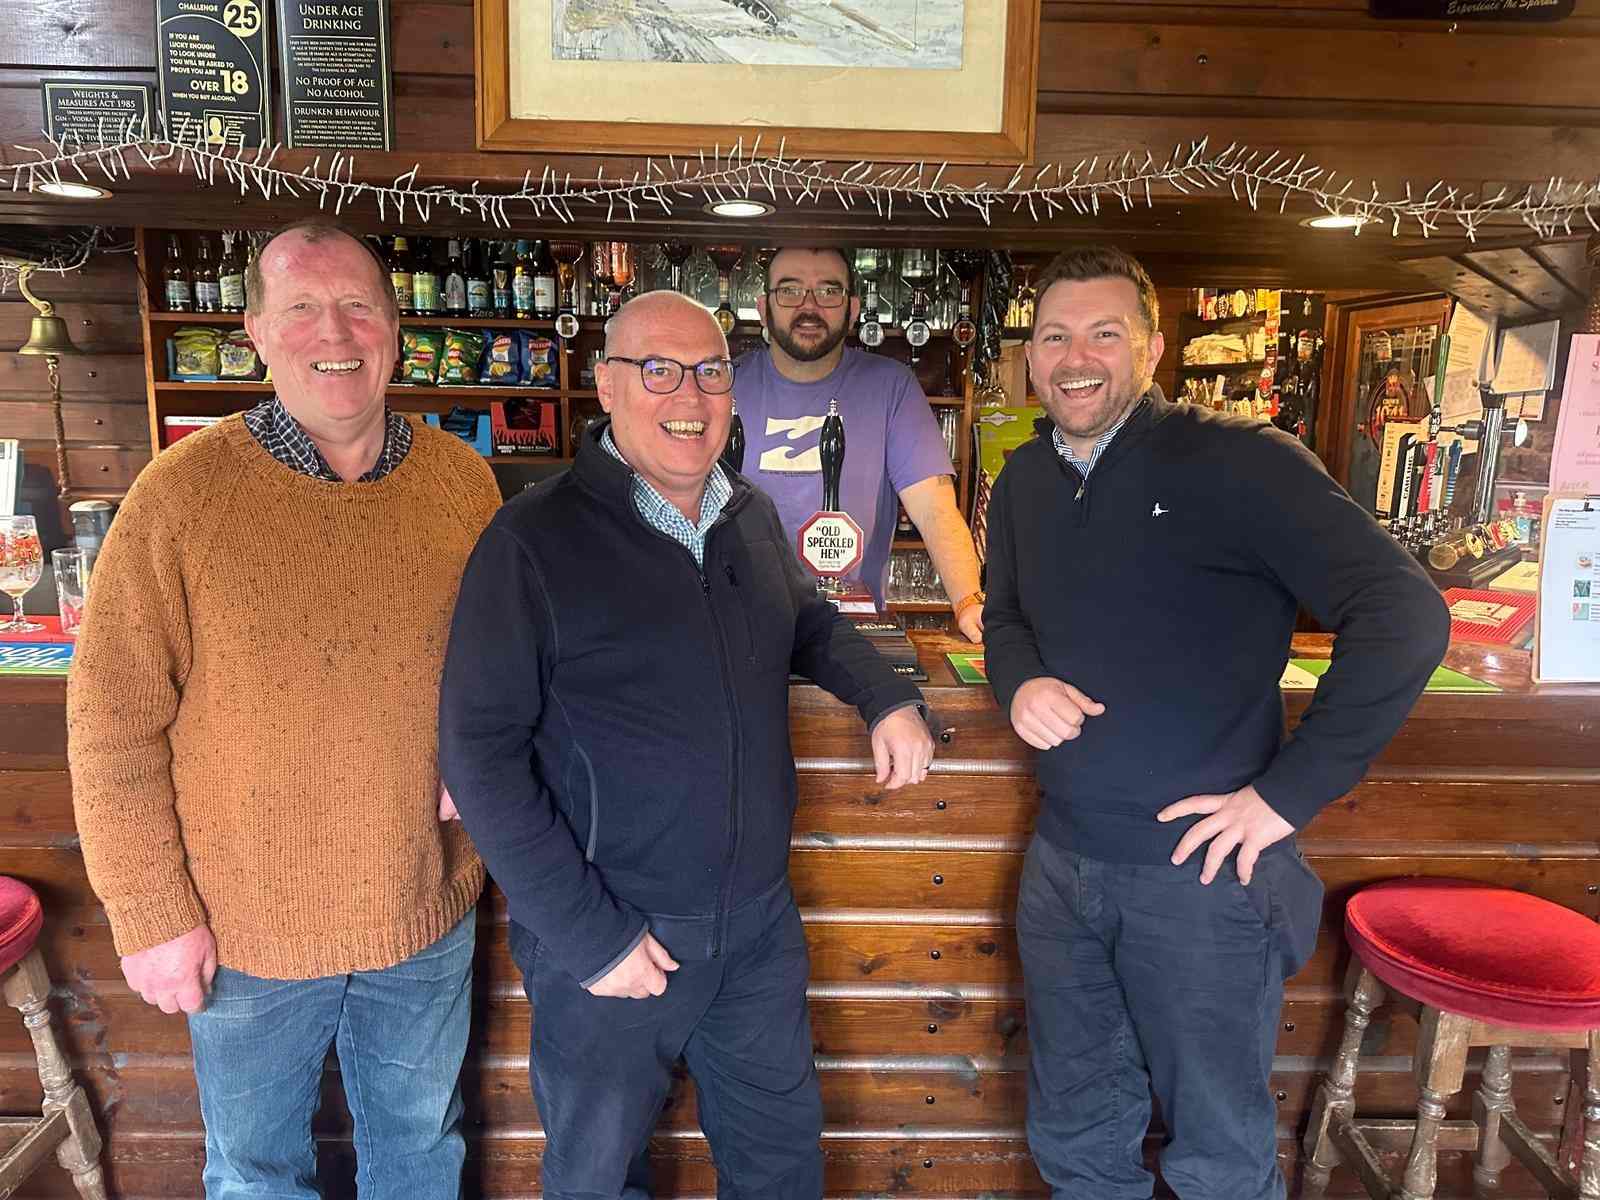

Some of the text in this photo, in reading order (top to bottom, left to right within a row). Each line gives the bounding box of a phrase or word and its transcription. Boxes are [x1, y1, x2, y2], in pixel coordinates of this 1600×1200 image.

[178, 3, 257, 29] CHALLENGE 25
[299, 4, 364, 17] UNDER AGE
[303, 18, 361, 31] DRINKING
[206, 60, 225, 68] ASKED
[190, 70, 249, 95] OVER 18
[295, 76, 376, 88] NO PROOF OF AGE
[72, 90, 109, 98] WEIGHTS
[307, 88, 364, 98] NO ALCOHOL
[58, 98, 136, 109] MEASURES ACT 1985
[294, 107, 380, 117] DRUNKEN BEHAVIOUR
[816, 526, 840, 536] "OLD
[807, 537, 854, 548] SPECKLED
[821, 549, 845, 559] HEN"
